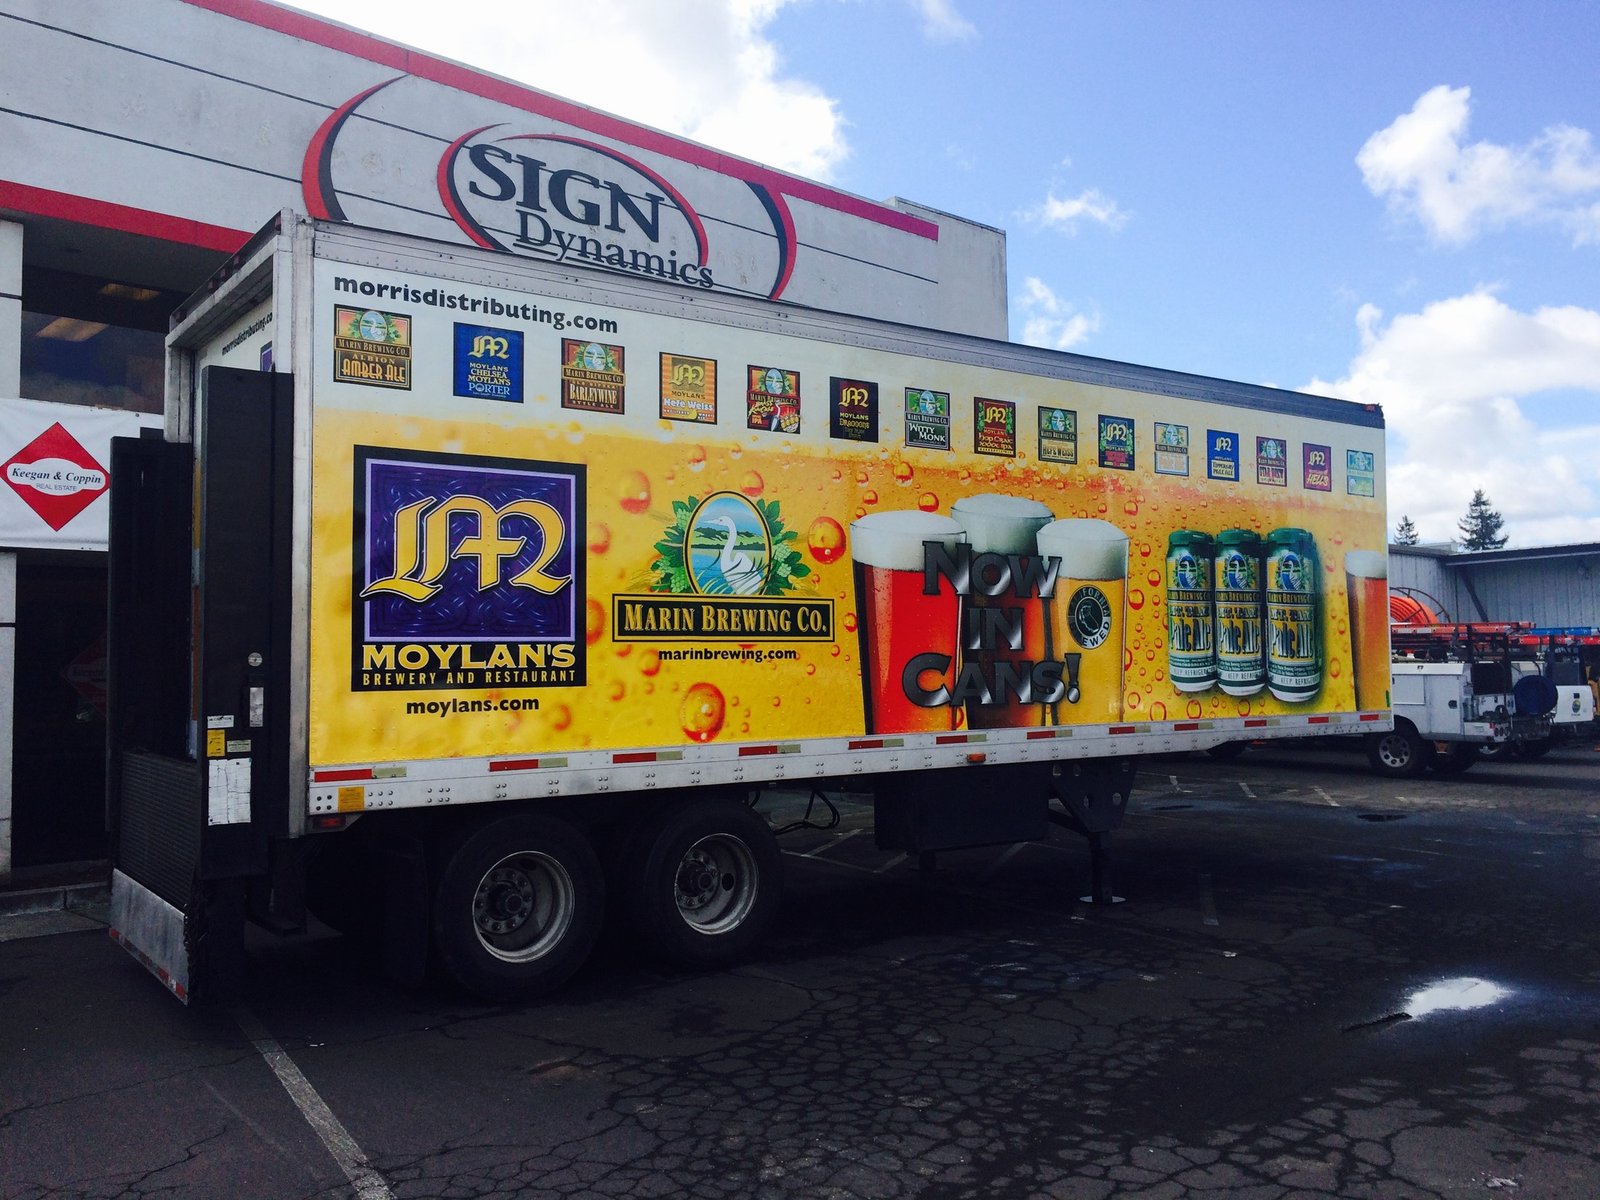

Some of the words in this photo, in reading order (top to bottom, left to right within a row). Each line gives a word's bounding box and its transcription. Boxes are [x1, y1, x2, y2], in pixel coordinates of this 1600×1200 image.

[469, 143, 665, 243] SIGN
[514, 208, 714, 289] Dynamics
[334, 275, 618, 334] morrisdistributing.com
[352, 353, 395, 364] ALBION
[342, 358, 383, 380] AMBER
[384, 364, 405, 383] ALE
[470, 368, 508, 379] CHELSEA
[468, 382, 510, 396] PORTER
[569, 383, 617, 405] BARLEYWINE
[909, 422, 935, 434] WITTY
[919, 431, 945, 442] MONK
[12, 467, 50, 480] Keegan
[53, 471, 62, 481] &
[66, 472, 101, 485] Coppin
[36, 482, 53, 490] REAL
[54, 484, 77, 492] ESTATE
[921, 540, 1063, 599] NOW
[624, 603, 695, 632] MARIN
[701, 605, 792, 633] BREWING
[797, 606, 828, 633] CO.
[967, 607, 1025, 651] IN
[361, 643, 575, 671] MOYLAN'S
[658, 647, 797, 662] marinbrewing.com
[362, 672, 437, 687] BREWERY
[446, 671, 475, 685] AND
[485, 669, 575, 684] RESTAURANT
[901, 652, 1082, 708] CANS!
[406, 698, 540, 717] moylans.com
